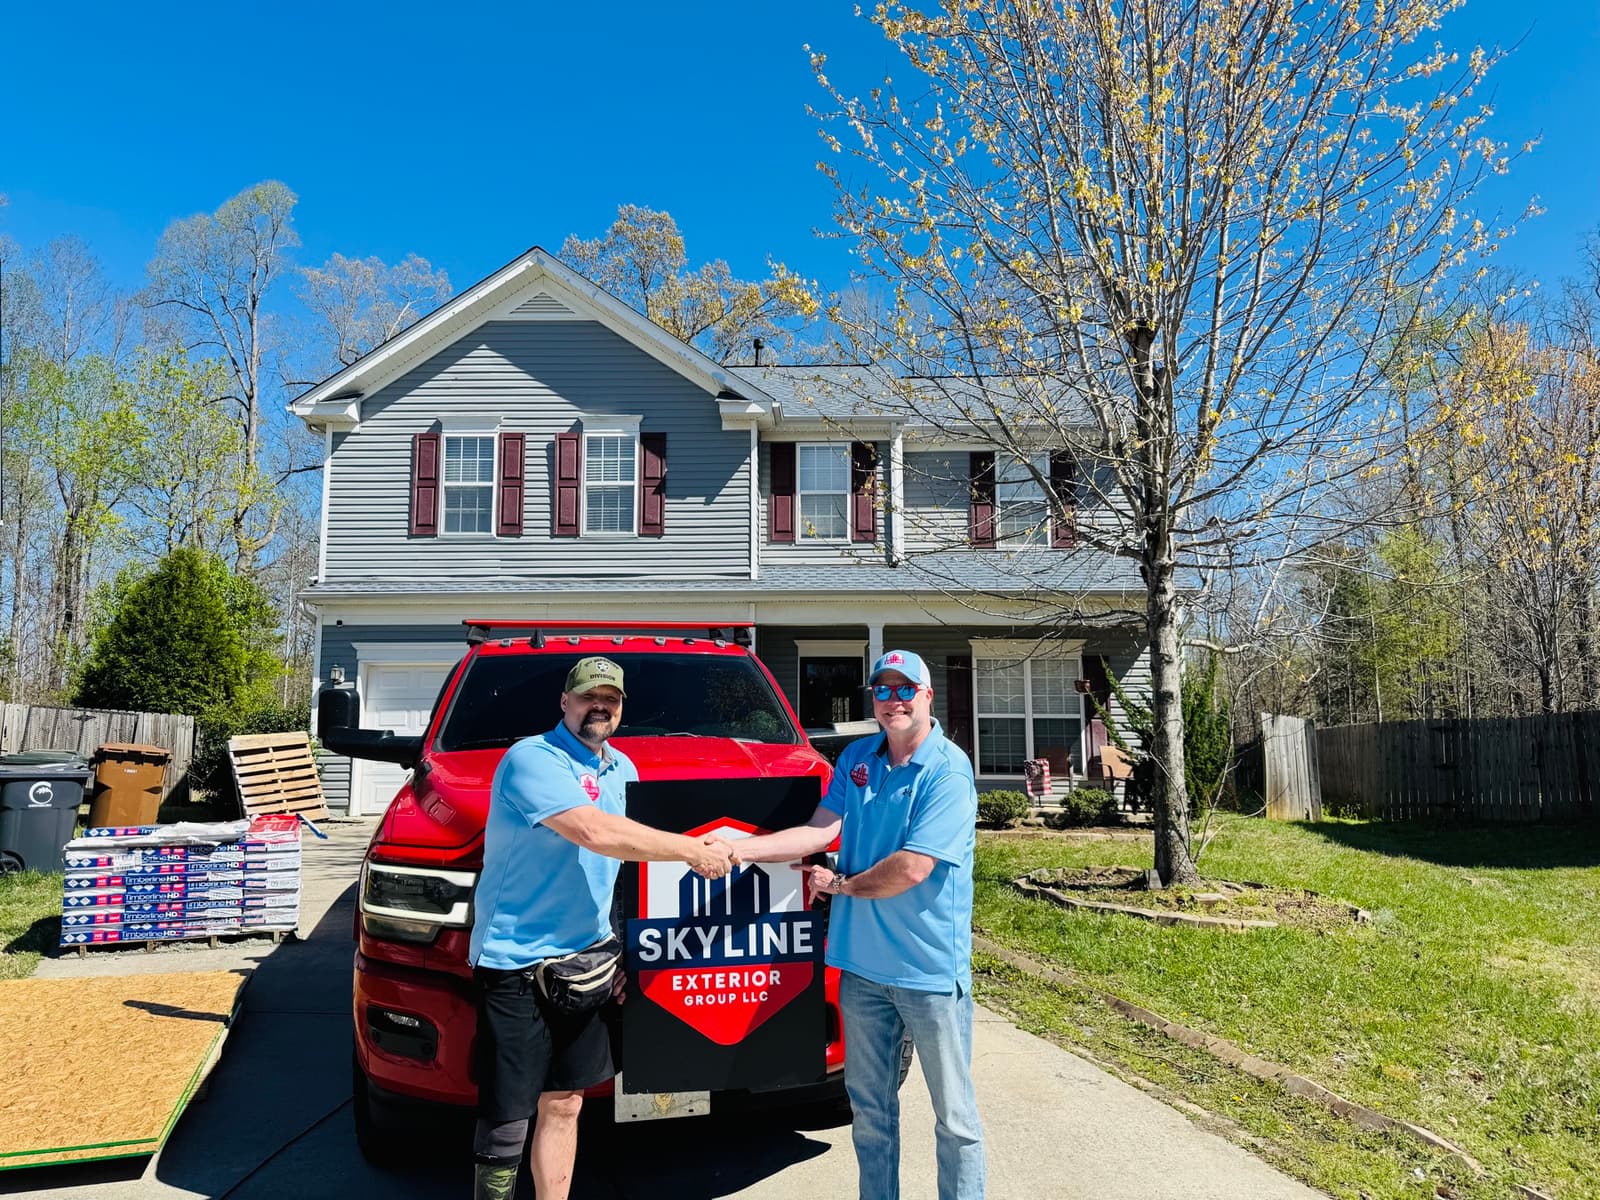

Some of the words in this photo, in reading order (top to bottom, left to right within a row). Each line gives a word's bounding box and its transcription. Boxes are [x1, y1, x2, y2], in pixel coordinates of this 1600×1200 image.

[639, 921, 814, 962] SKYLINE
[672, 970, 782, 991] EXTERIOR
[684, 993, 737, 1006] GROUP
[743, 991, 769, 1004] LLC
